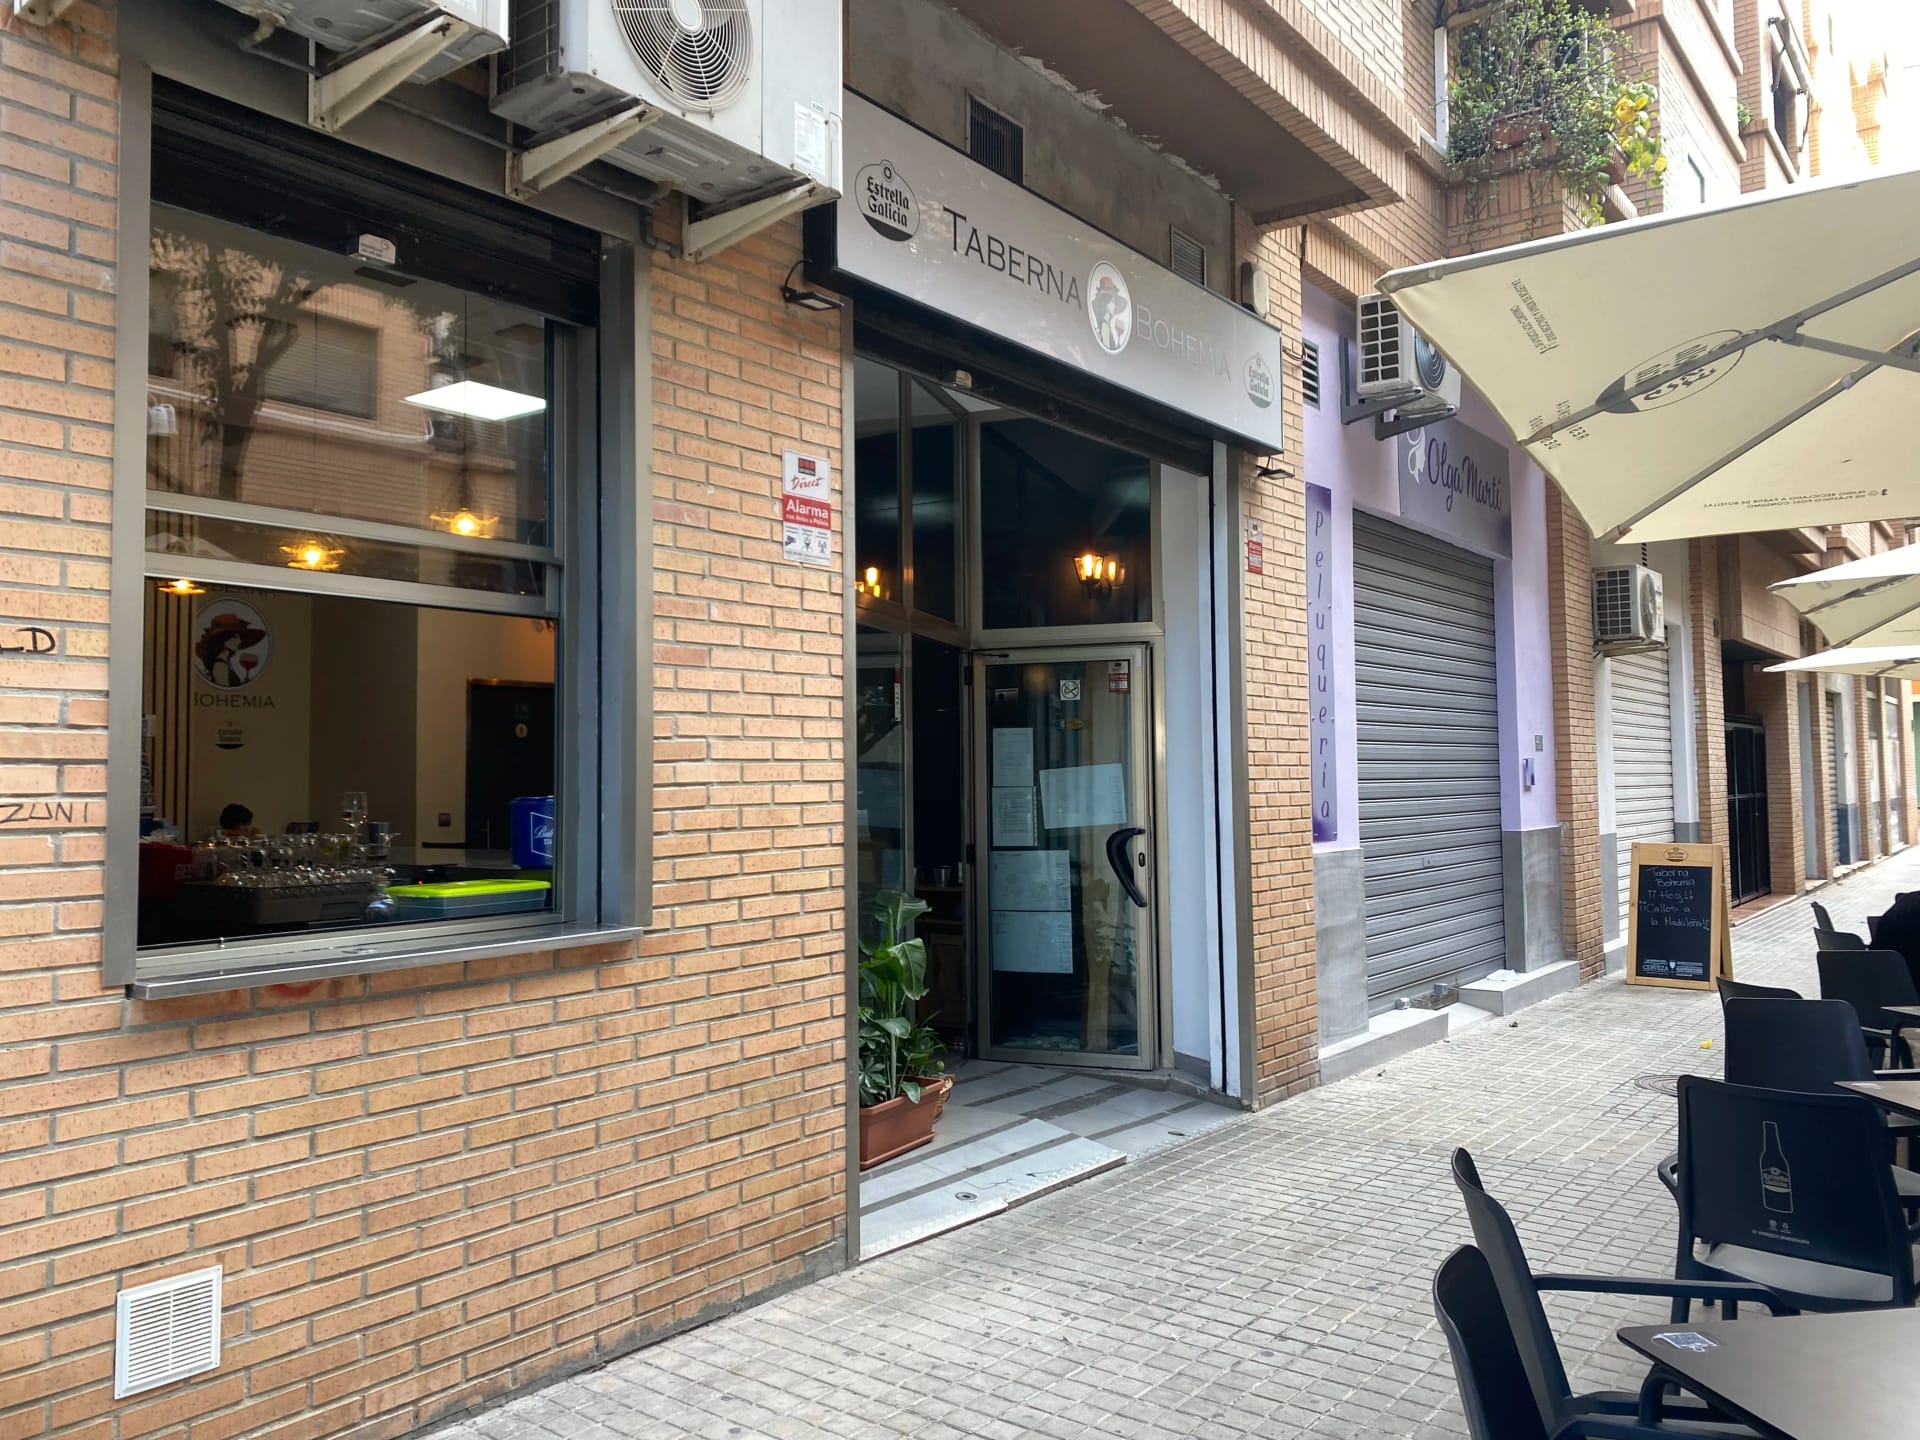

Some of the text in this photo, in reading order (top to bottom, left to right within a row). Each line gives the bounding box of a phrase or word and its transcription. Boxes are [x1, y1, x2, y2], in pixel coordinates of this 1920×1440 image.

[867, 176, 909, 210] Estrella
[868, 195, 907, 227] Galicia
[943, 205, 1232, 383] TABERNA BOHEMIA
[1249, 365, 1269, 386] Estrella
[1250, 378, 1268, 398] Galicia
[1428, 438, 1463, 512] Olga
[787, 499, 829, 518] Alarma
[1645, 867, 1689, 877] Taberna
[1656, 878, 1695, 887] Bohemia
